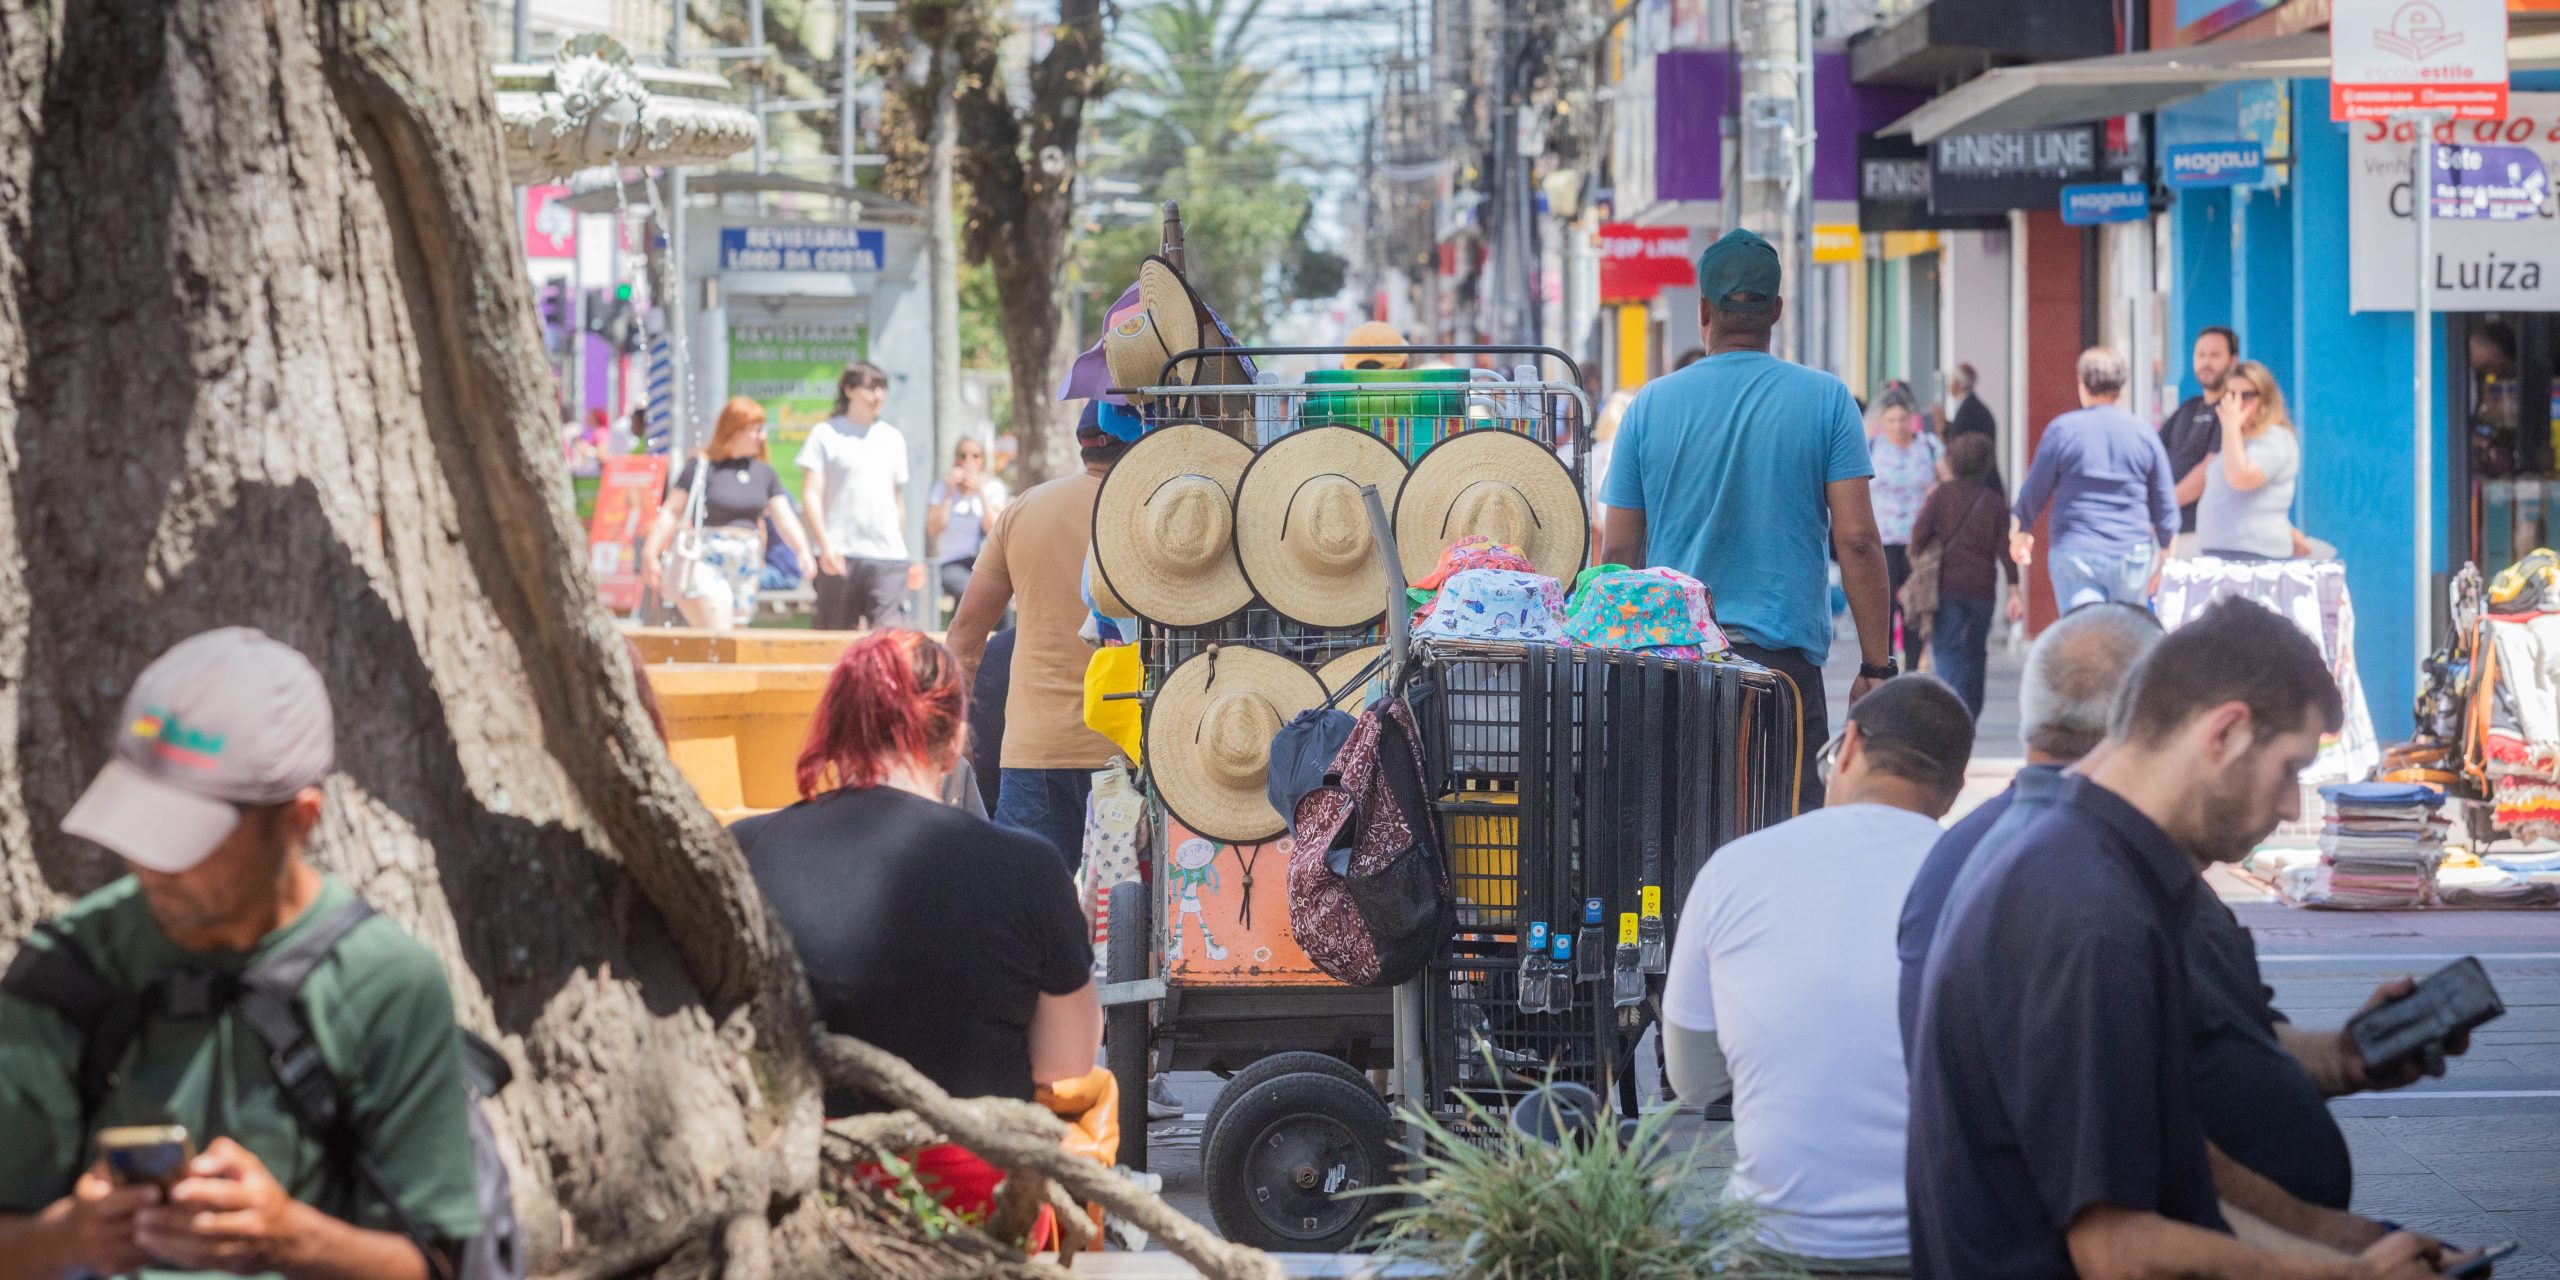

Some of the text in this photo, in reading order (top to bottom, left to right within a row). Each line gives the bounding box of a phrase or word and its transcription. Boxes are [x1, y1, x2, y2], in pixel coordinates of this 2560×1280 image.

[2032, 129, 2090, 166] LINE
[745, 226, 859, 248] REVISTARIA
[728, 248, 876, 271] LOBO DA COSTA
[2436, 252, 2541, 291] Luiza
